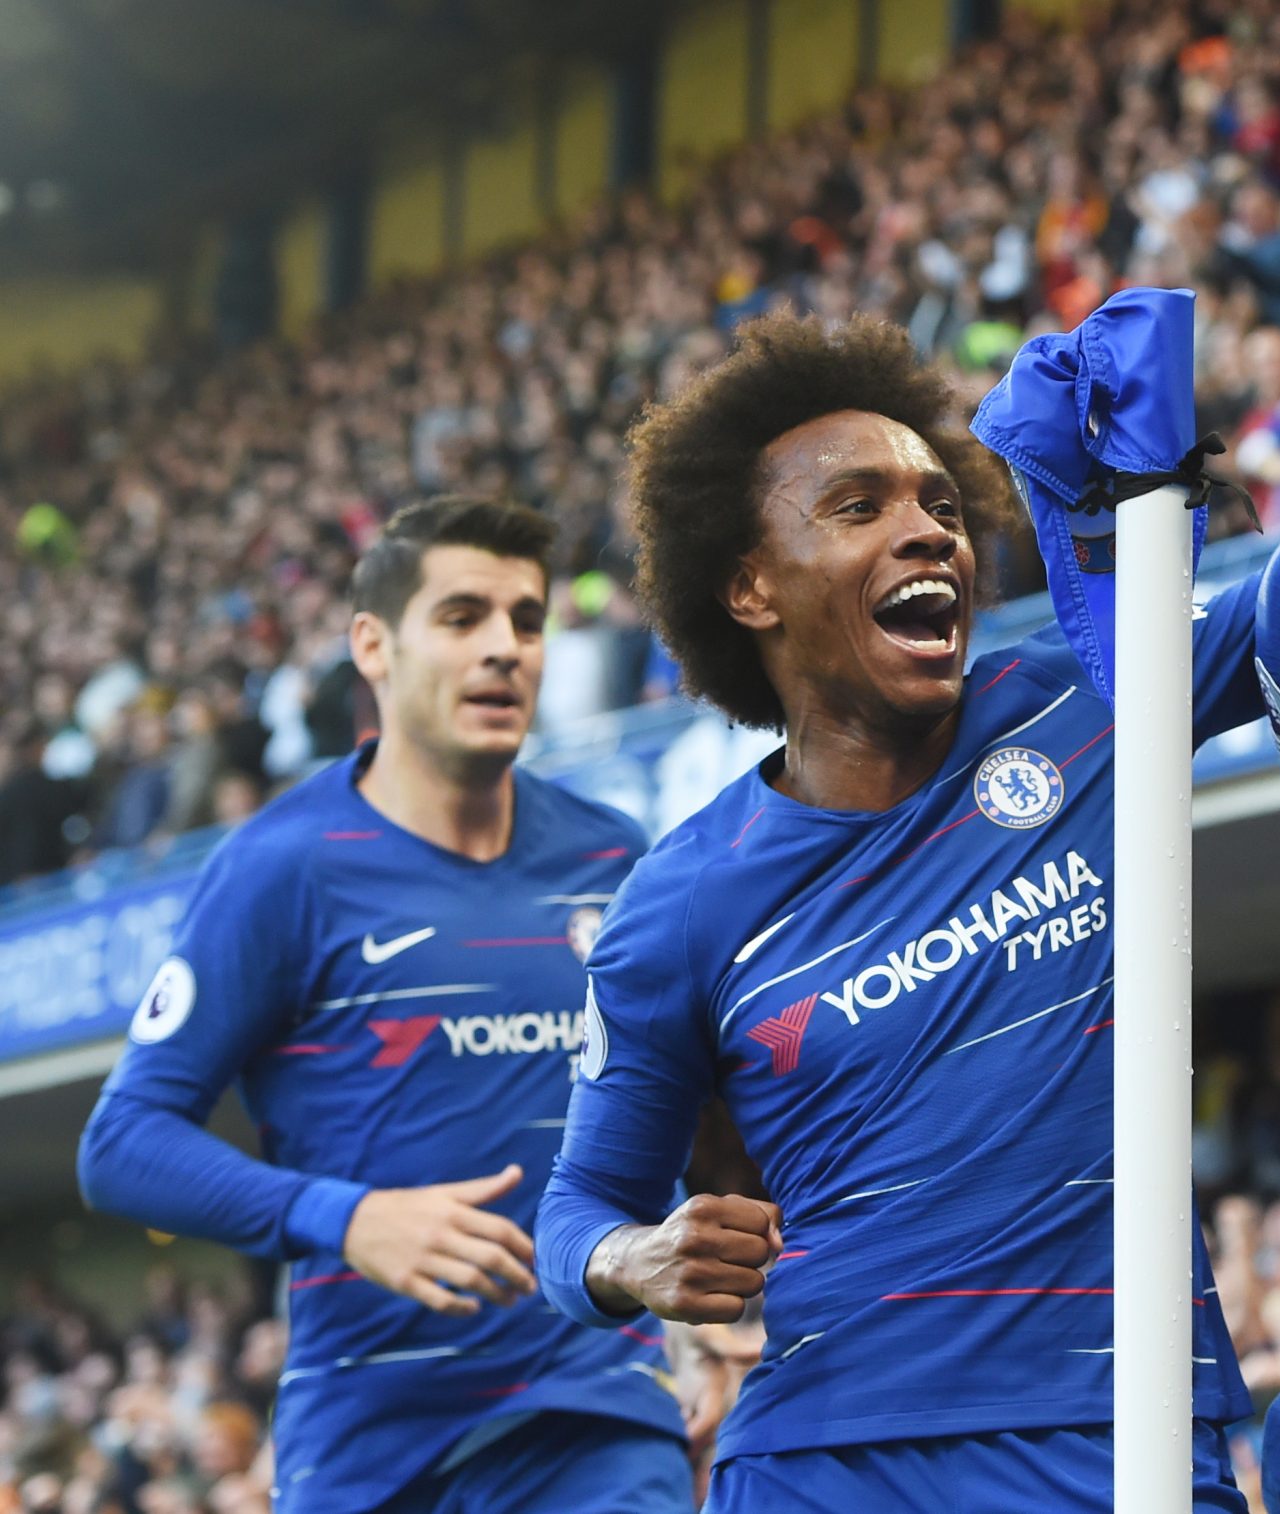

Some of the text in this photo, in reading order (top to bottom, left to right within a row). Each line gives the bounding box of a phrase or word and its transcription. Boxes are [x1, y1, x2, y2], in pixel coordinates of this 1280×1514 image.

[980, 750, 1030, 782] CHELSEA
[1007, 812, 1047, 825] FOOTBALL
[820, 850, 1104, 1026] YOKOHAMA
[1003, 896, 1107, 972] TYRES
